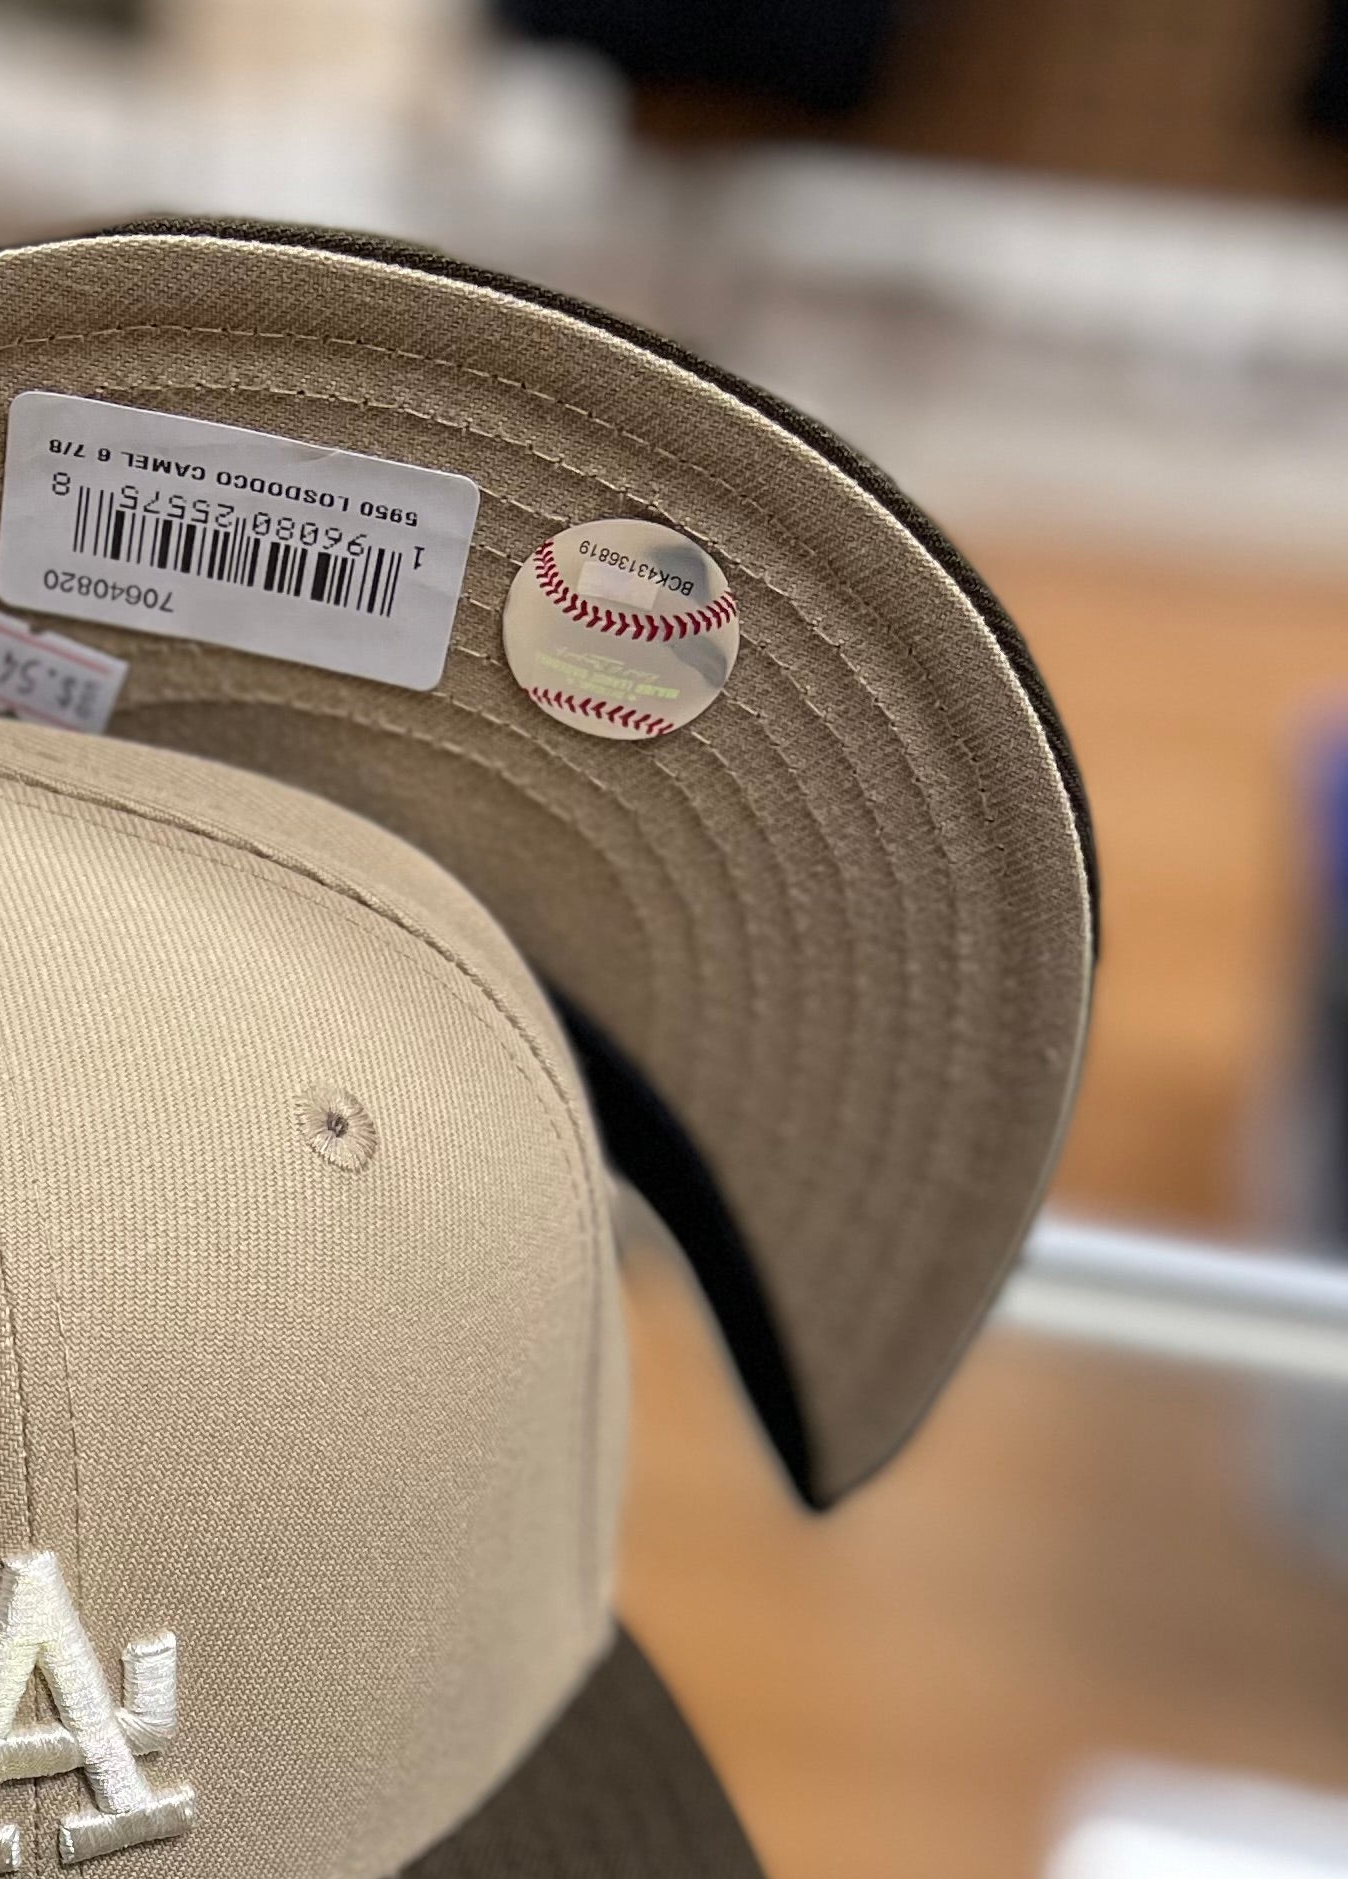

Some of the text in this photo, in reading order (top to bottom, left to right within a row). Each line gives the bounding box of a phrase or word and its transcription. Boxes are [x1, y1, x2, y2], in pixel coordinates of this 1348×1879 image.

[48, 438, 419, 527] 5950 LOSDODCO CAMEL 6 7/8
[51, 471, 427, 571] 1 96080 25575 8
[43, 567, 176, 613] 70640820
[578, 540, 695, 597] BCK43136819
